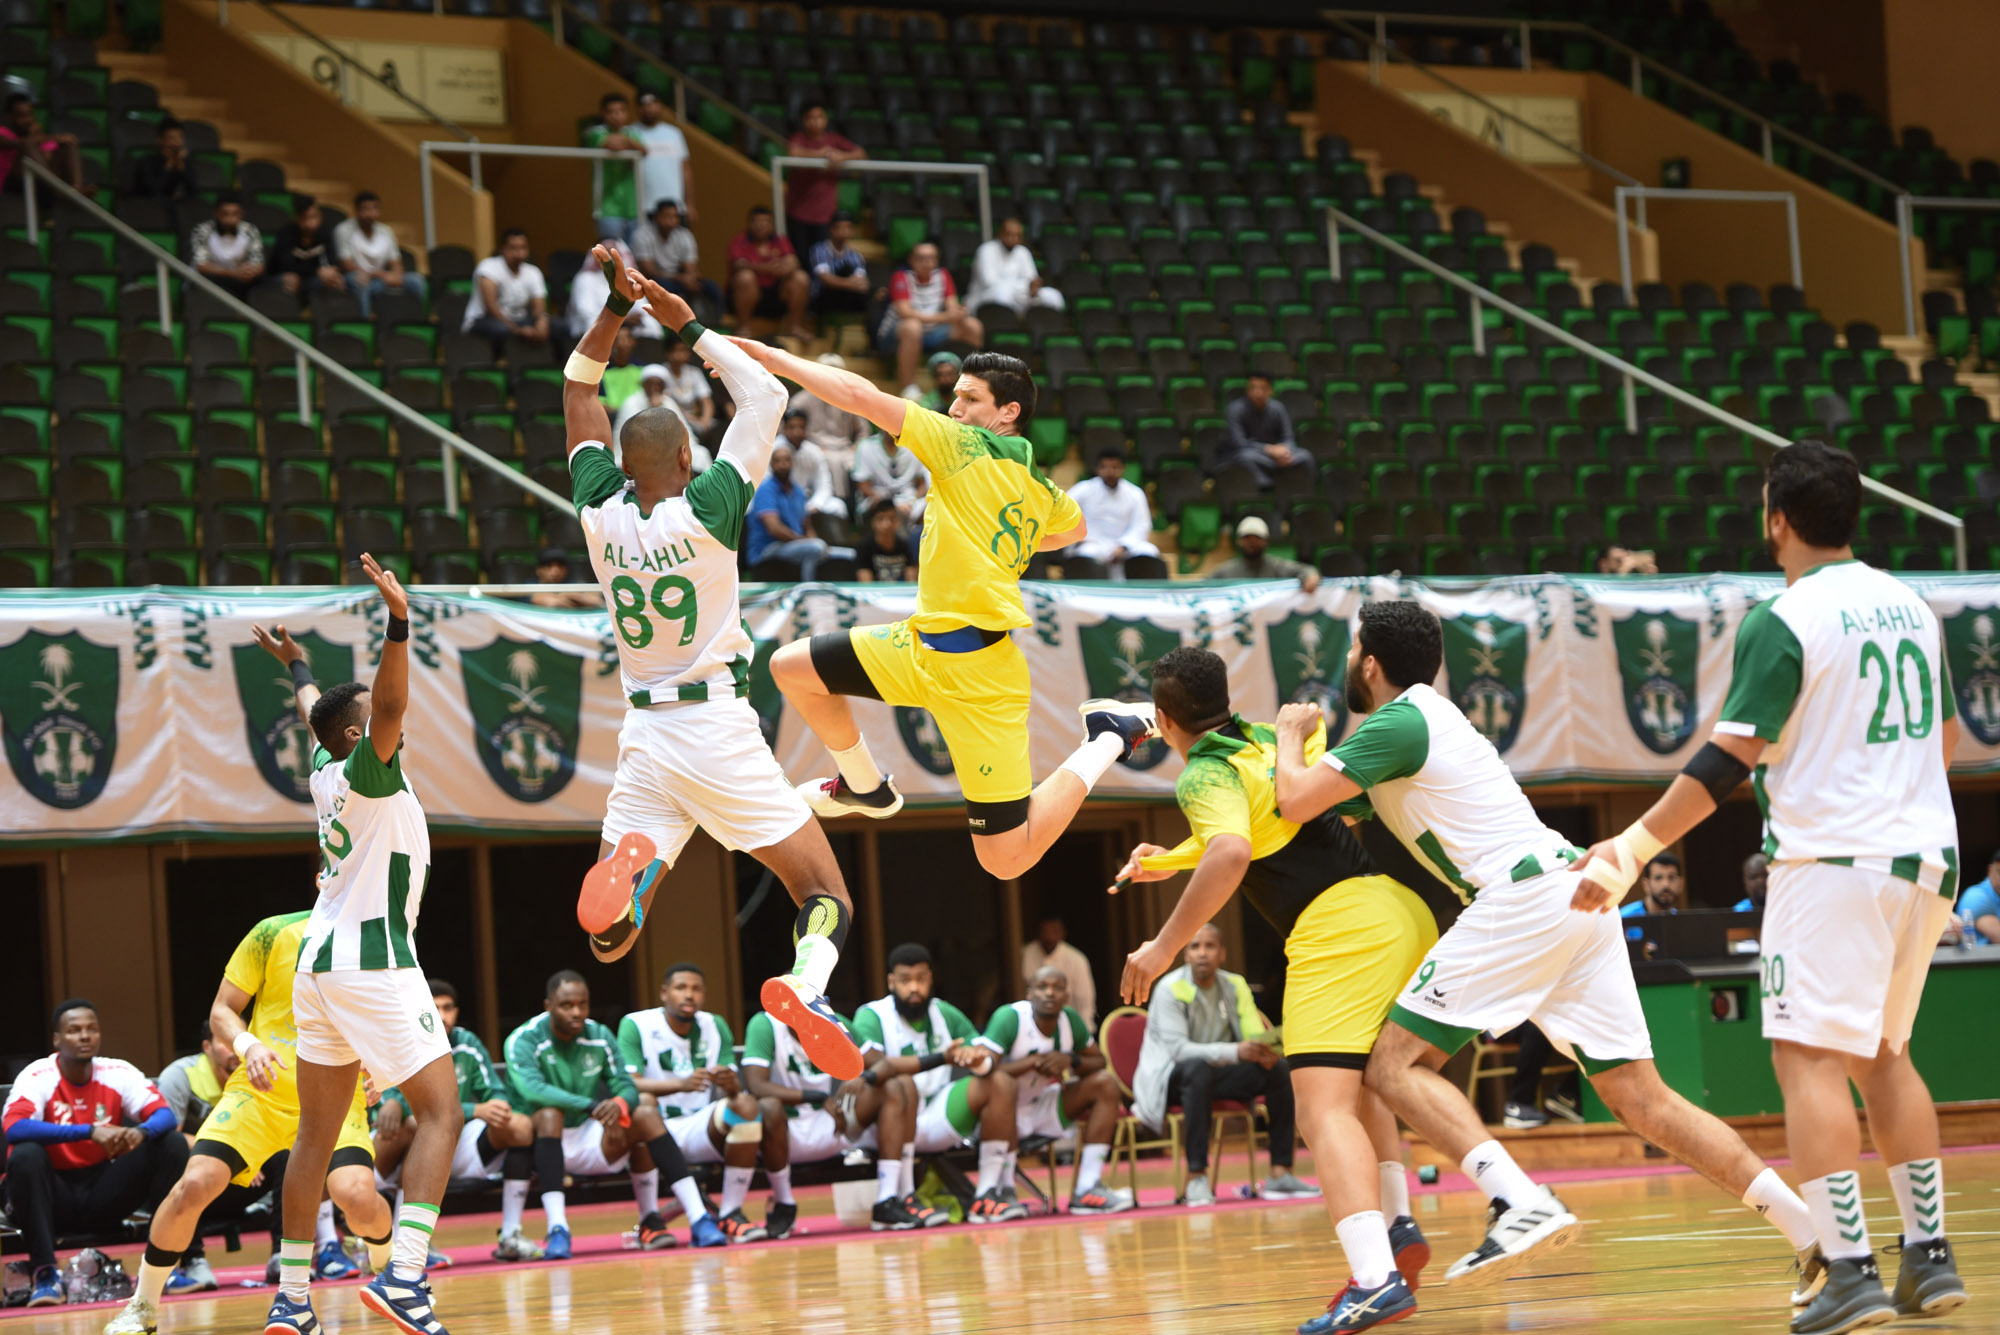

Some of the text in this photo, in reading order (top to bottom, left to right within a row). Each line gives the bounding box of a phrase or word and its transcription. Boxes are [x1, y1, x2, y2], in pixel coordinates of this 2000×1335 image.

[603, 537, 697, 572] AL-AHLI
[610, 574, 698, 649] 89
[1840, 604, 1926, 636] AL-AHLI
[1859, 637, 1934, 745] 20
[1410, 960, 1437, 994] 9
[1761, 953, 1785, 998] 20
